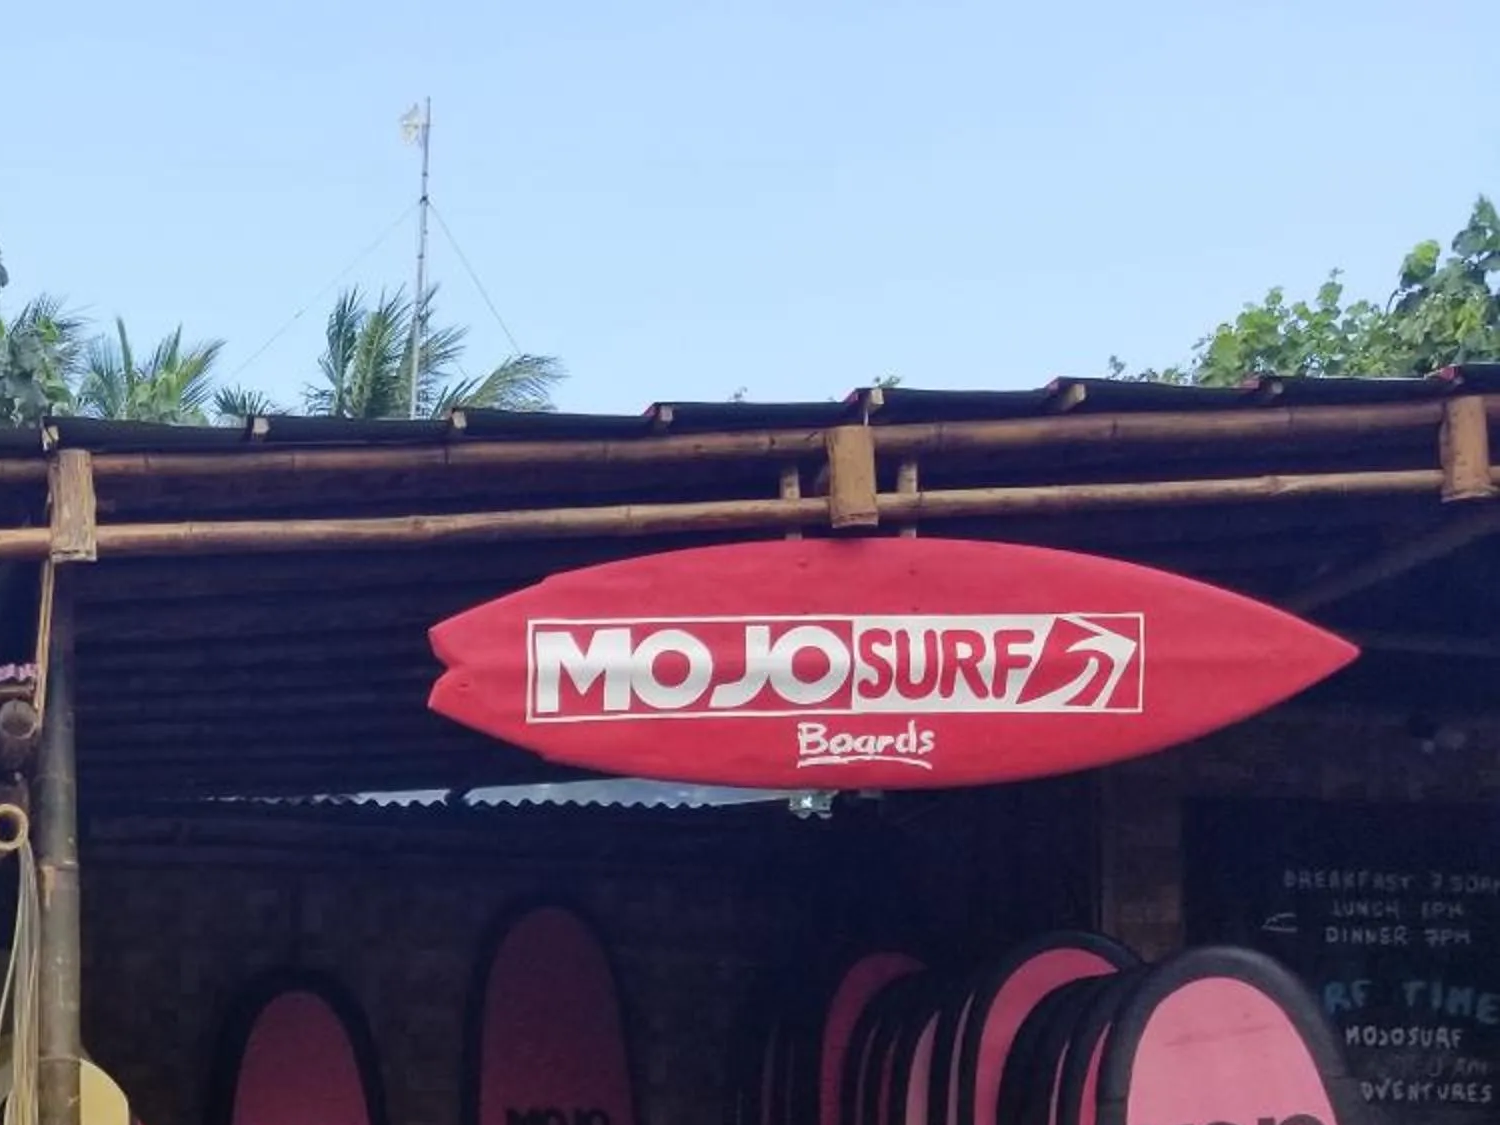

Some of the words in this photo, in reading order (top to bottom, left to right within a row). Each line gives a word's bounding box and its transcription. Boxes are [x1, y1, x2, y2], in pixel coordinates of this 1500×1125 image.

[534, 625, 850, 712] MOJO
[857, 628, 1037, 700] SURF
[797, 721, 934, 757] Boards
[1332, 900, 1400, 920] LUNCH
[1324, 925, 1409, 946] DINNER
[1324, 979, 1374, 1015] RF
[1360, 1077, 1493, 1104] DVENTURES
